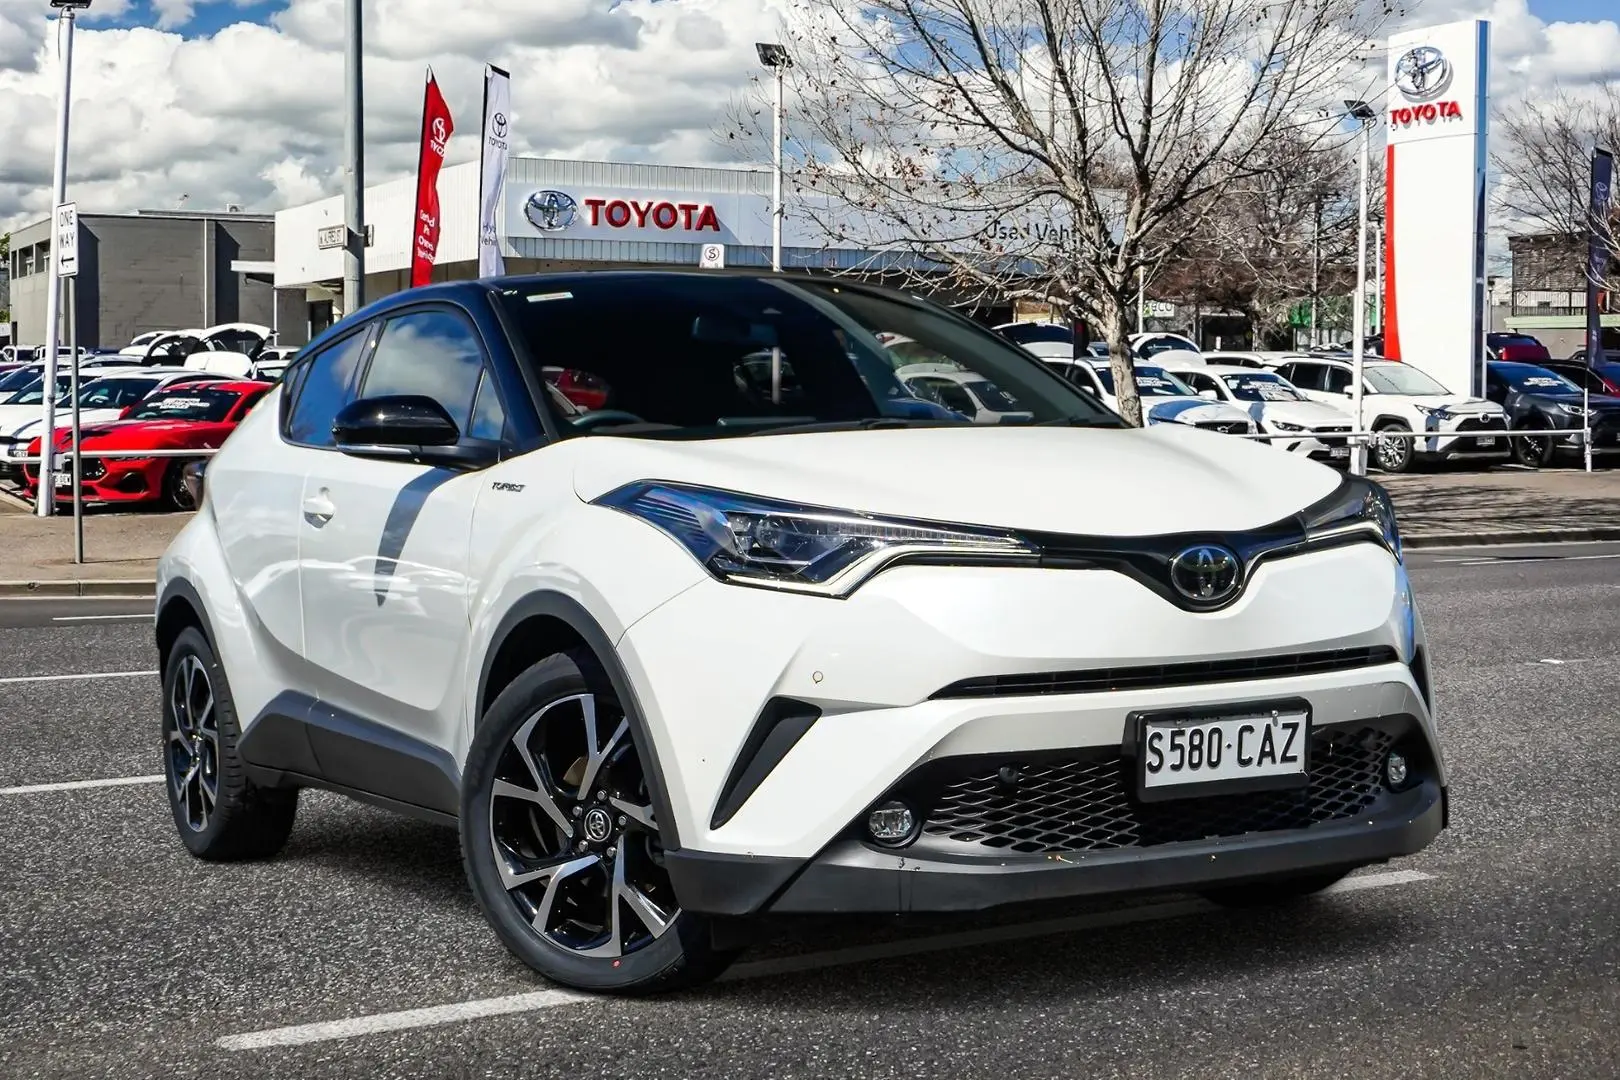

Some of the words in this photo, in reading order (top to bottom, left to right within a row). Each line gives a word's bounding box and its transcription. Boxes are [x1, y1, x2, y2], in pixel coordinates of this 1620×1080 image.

[1390, 101, 1462, 124] TOYOTA
[60, 209, 74, 227] ONE
[584, 199, 721, 231] TOYOTA
[986, 221, 1030, 239] Used
[59, 231, 75, 249] WAY
